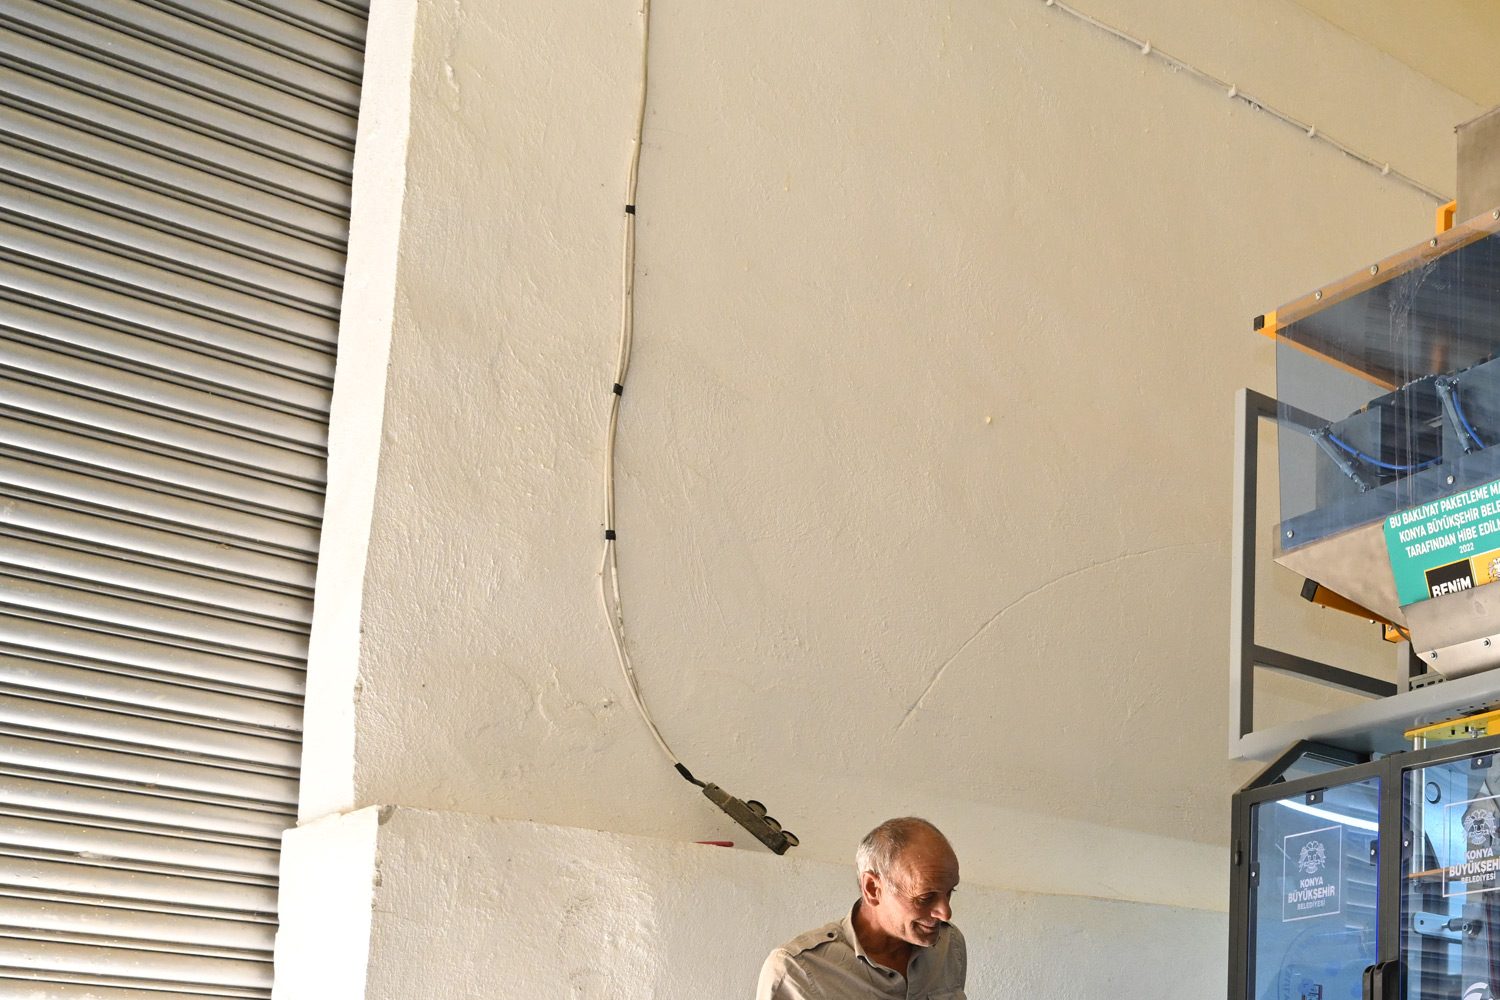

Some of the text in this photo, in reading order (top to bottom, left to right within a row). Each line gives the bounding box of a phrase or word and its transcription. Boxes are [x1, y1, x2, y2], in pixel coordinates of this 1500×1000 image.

[1390, 514, 1402, 529] BU
[1402, 502, 1439, 525] BAKLİYAT
[1440, 486, 1489, 512] PAKETLEME
[1398, 524, 1427, 543] KONYA
[1426, 508, 1480, 535] BÜYÜKŞEHİR
[1405, 532, 1457, 558] TARAFINDAN
[1457, 526, 1478, 543] HİBE
[1459, 542, 1475, 554] 2022
[1465, 847, 1494, 860] KONYA
[1300, 876, 1324, 888] KONYA
[1461, 871, 1496, 884] BELEDİYESİ
[1288, 884, 1335, 904] BÜYÜKŞEHİR
